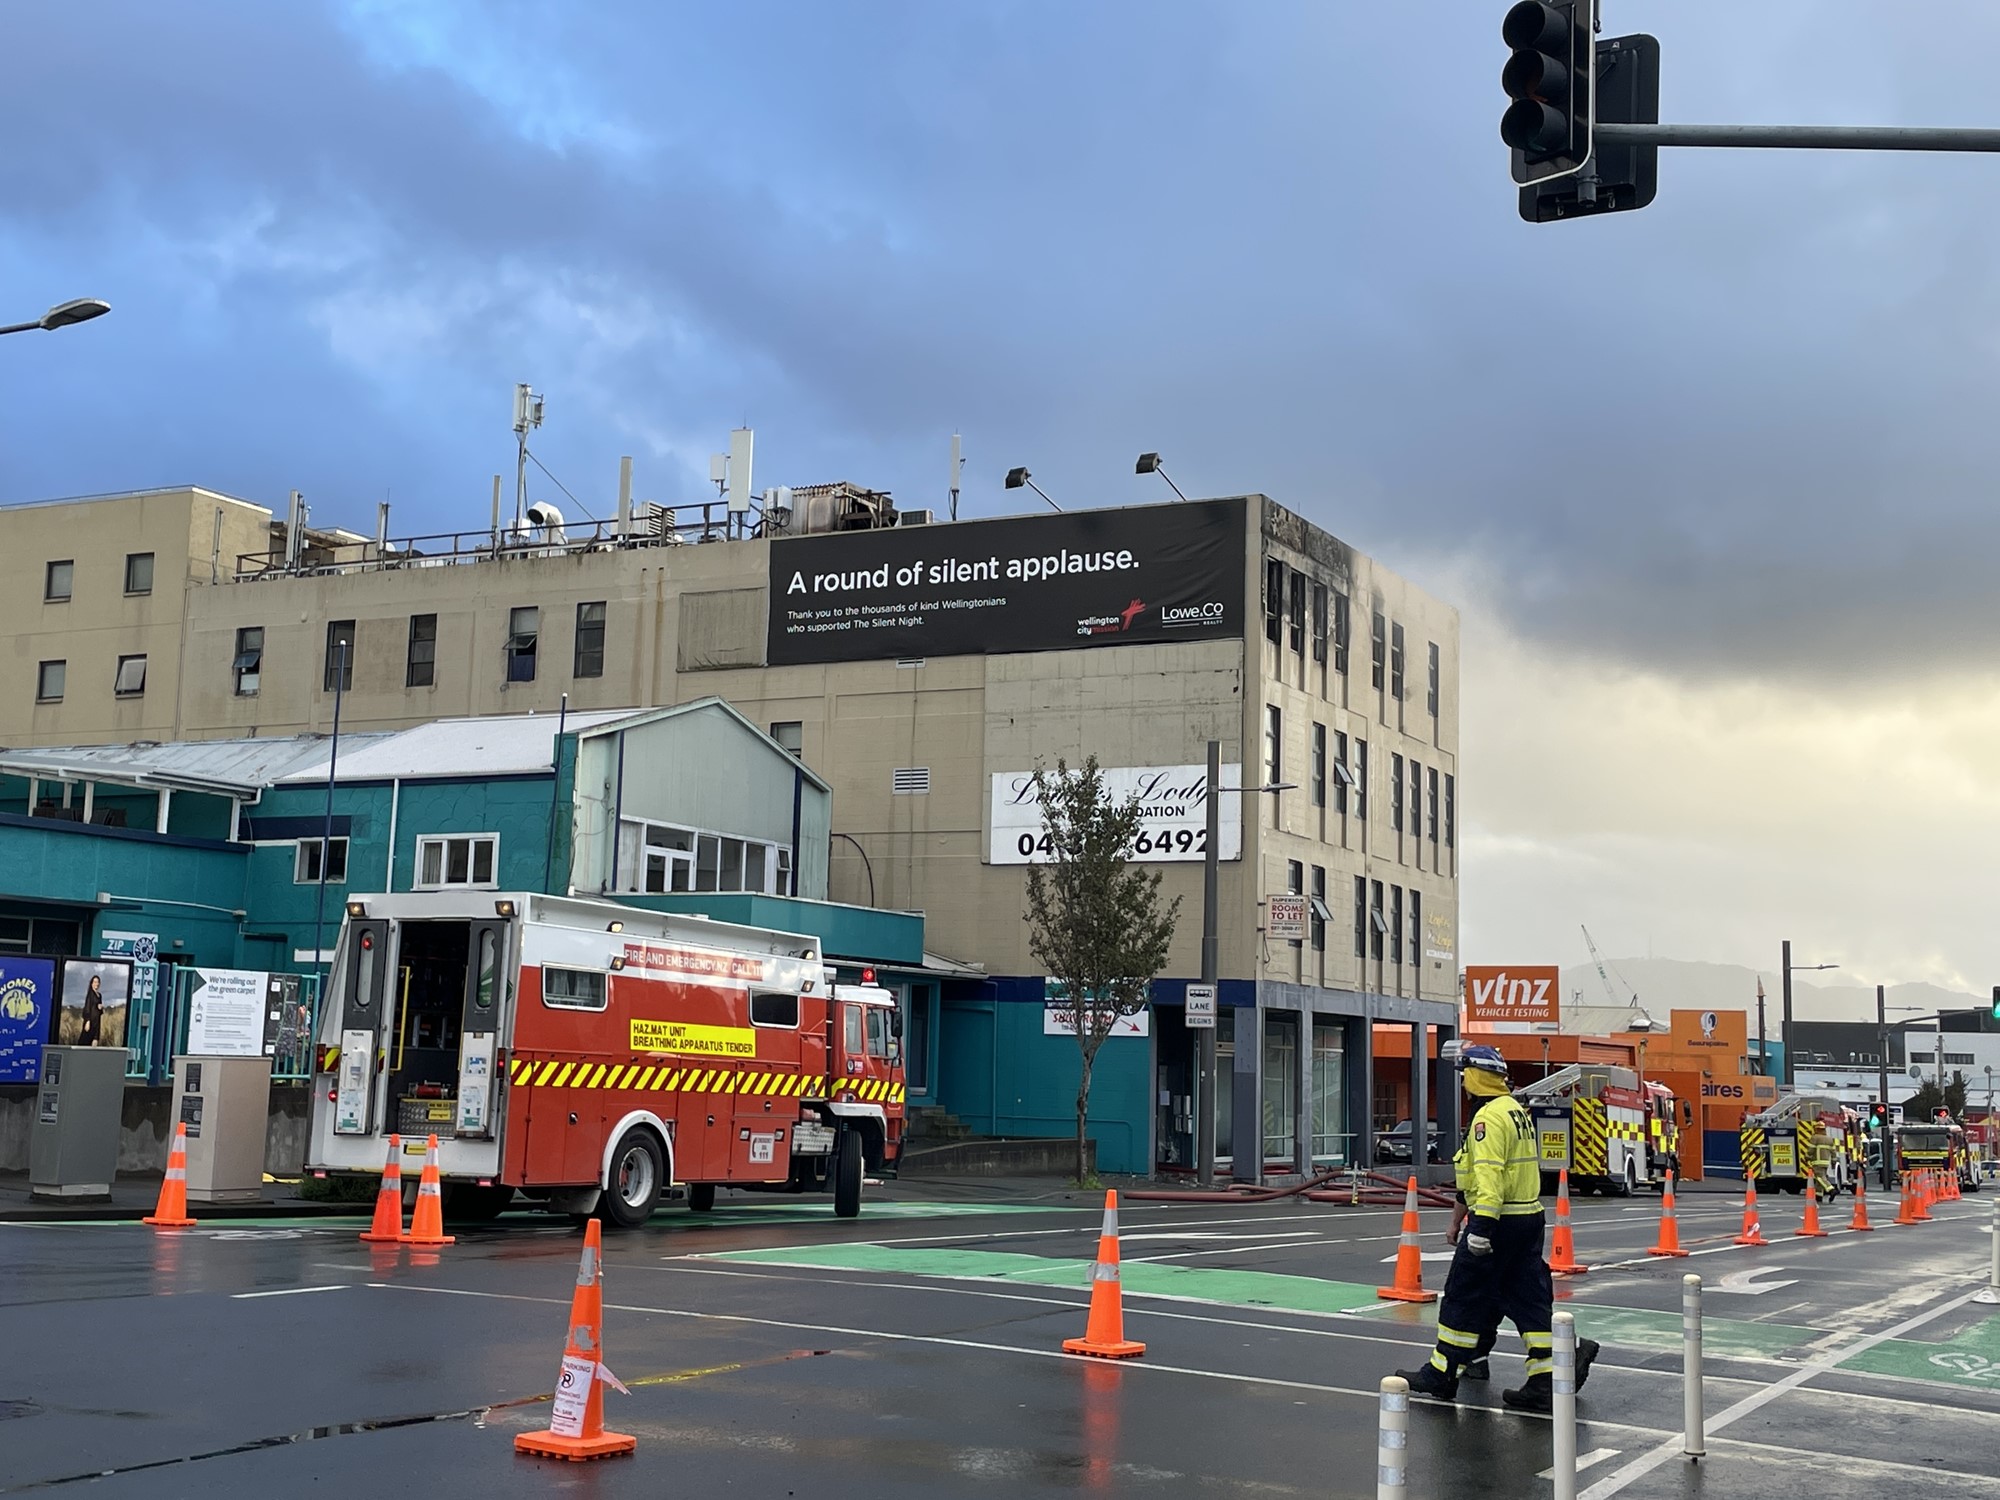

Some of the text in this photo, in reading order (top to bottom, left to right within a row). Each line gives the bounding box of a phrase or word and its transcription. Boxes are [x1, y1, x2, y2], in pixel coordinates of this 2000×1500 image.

[787, 549, 1140, 595] A round of silent applause.
[787, 597, 1007, 620] Thank you to the thousands of kind Wellingtonians
[786, 616, 925, 633] who supported The Silent Night.
[1077, 616, 1119, 627] wellington
[1138, 771, 1207, 809] Lodg
[1272, 904, 1304, 912] ROOMS
[1272, 912, 1304, 920] TO LET
[107, 939, 125, 951] ZIP
[625, 949, 645, 963] FIRE
[646, 951, 664, 965] AND
[732, 962, 752, 976] CALL
[0, 977, 37, 995] WOMEN
[227, 976, 246, 987] rolling
[208, 984, 256, 996] the green carpet
[1472, 972, 1552, 1006] vtnz
[1189, 1003, 1210, 1011] LANE
[1476, 1007, 1550, 1018] VEHICLE TESTING
[1188, 1017, 1212, 1025] BEGINS
[669, 1026, 687, 1037] UNIT
[633, 1035, 753, 1054] BREATHING APPARATUS TENDER
[1542, 1132, 1565, 1142] FIRE
[1773, 1144, 1791, 1152] FIRE
[1546, 1150, 1563, 1159] AHI
